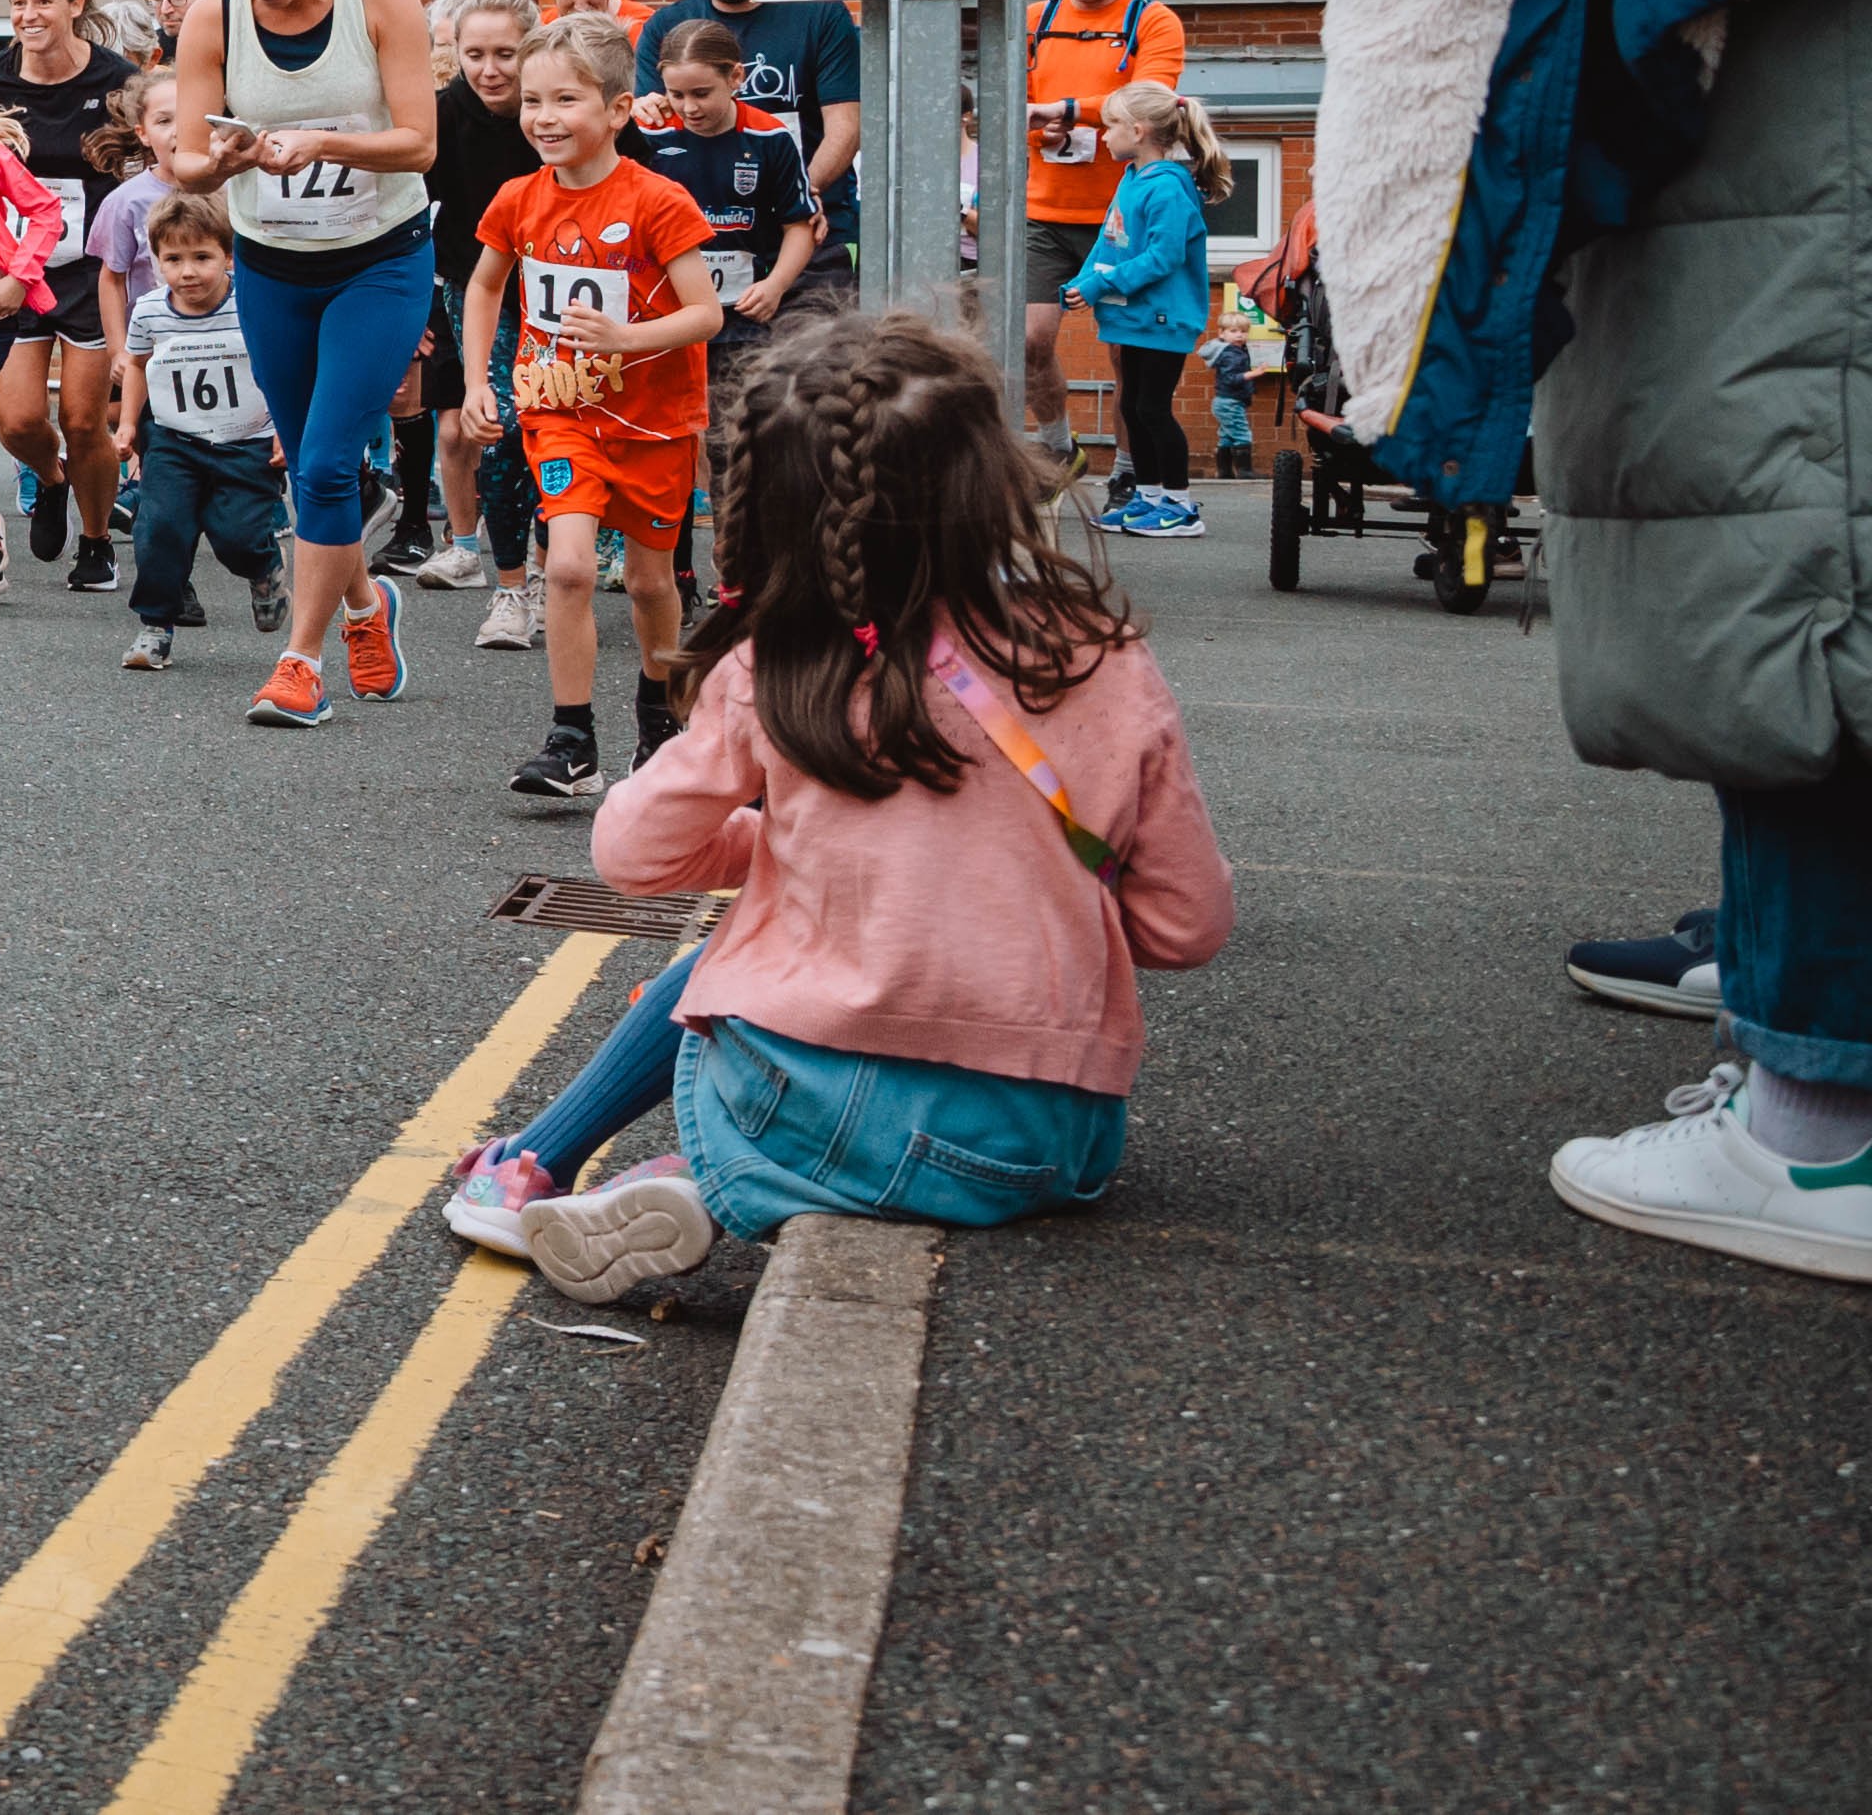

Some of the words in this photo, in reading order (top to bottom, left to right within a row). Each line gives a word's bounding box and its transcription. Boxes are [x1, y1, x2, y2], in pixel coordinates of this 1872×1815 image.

[704, 210, 749, 224] ionwide
[539, 274, 603, 323] 10
[172, 366, 239, 413] 161
[512, 353, 624, 409] SPIDEY
